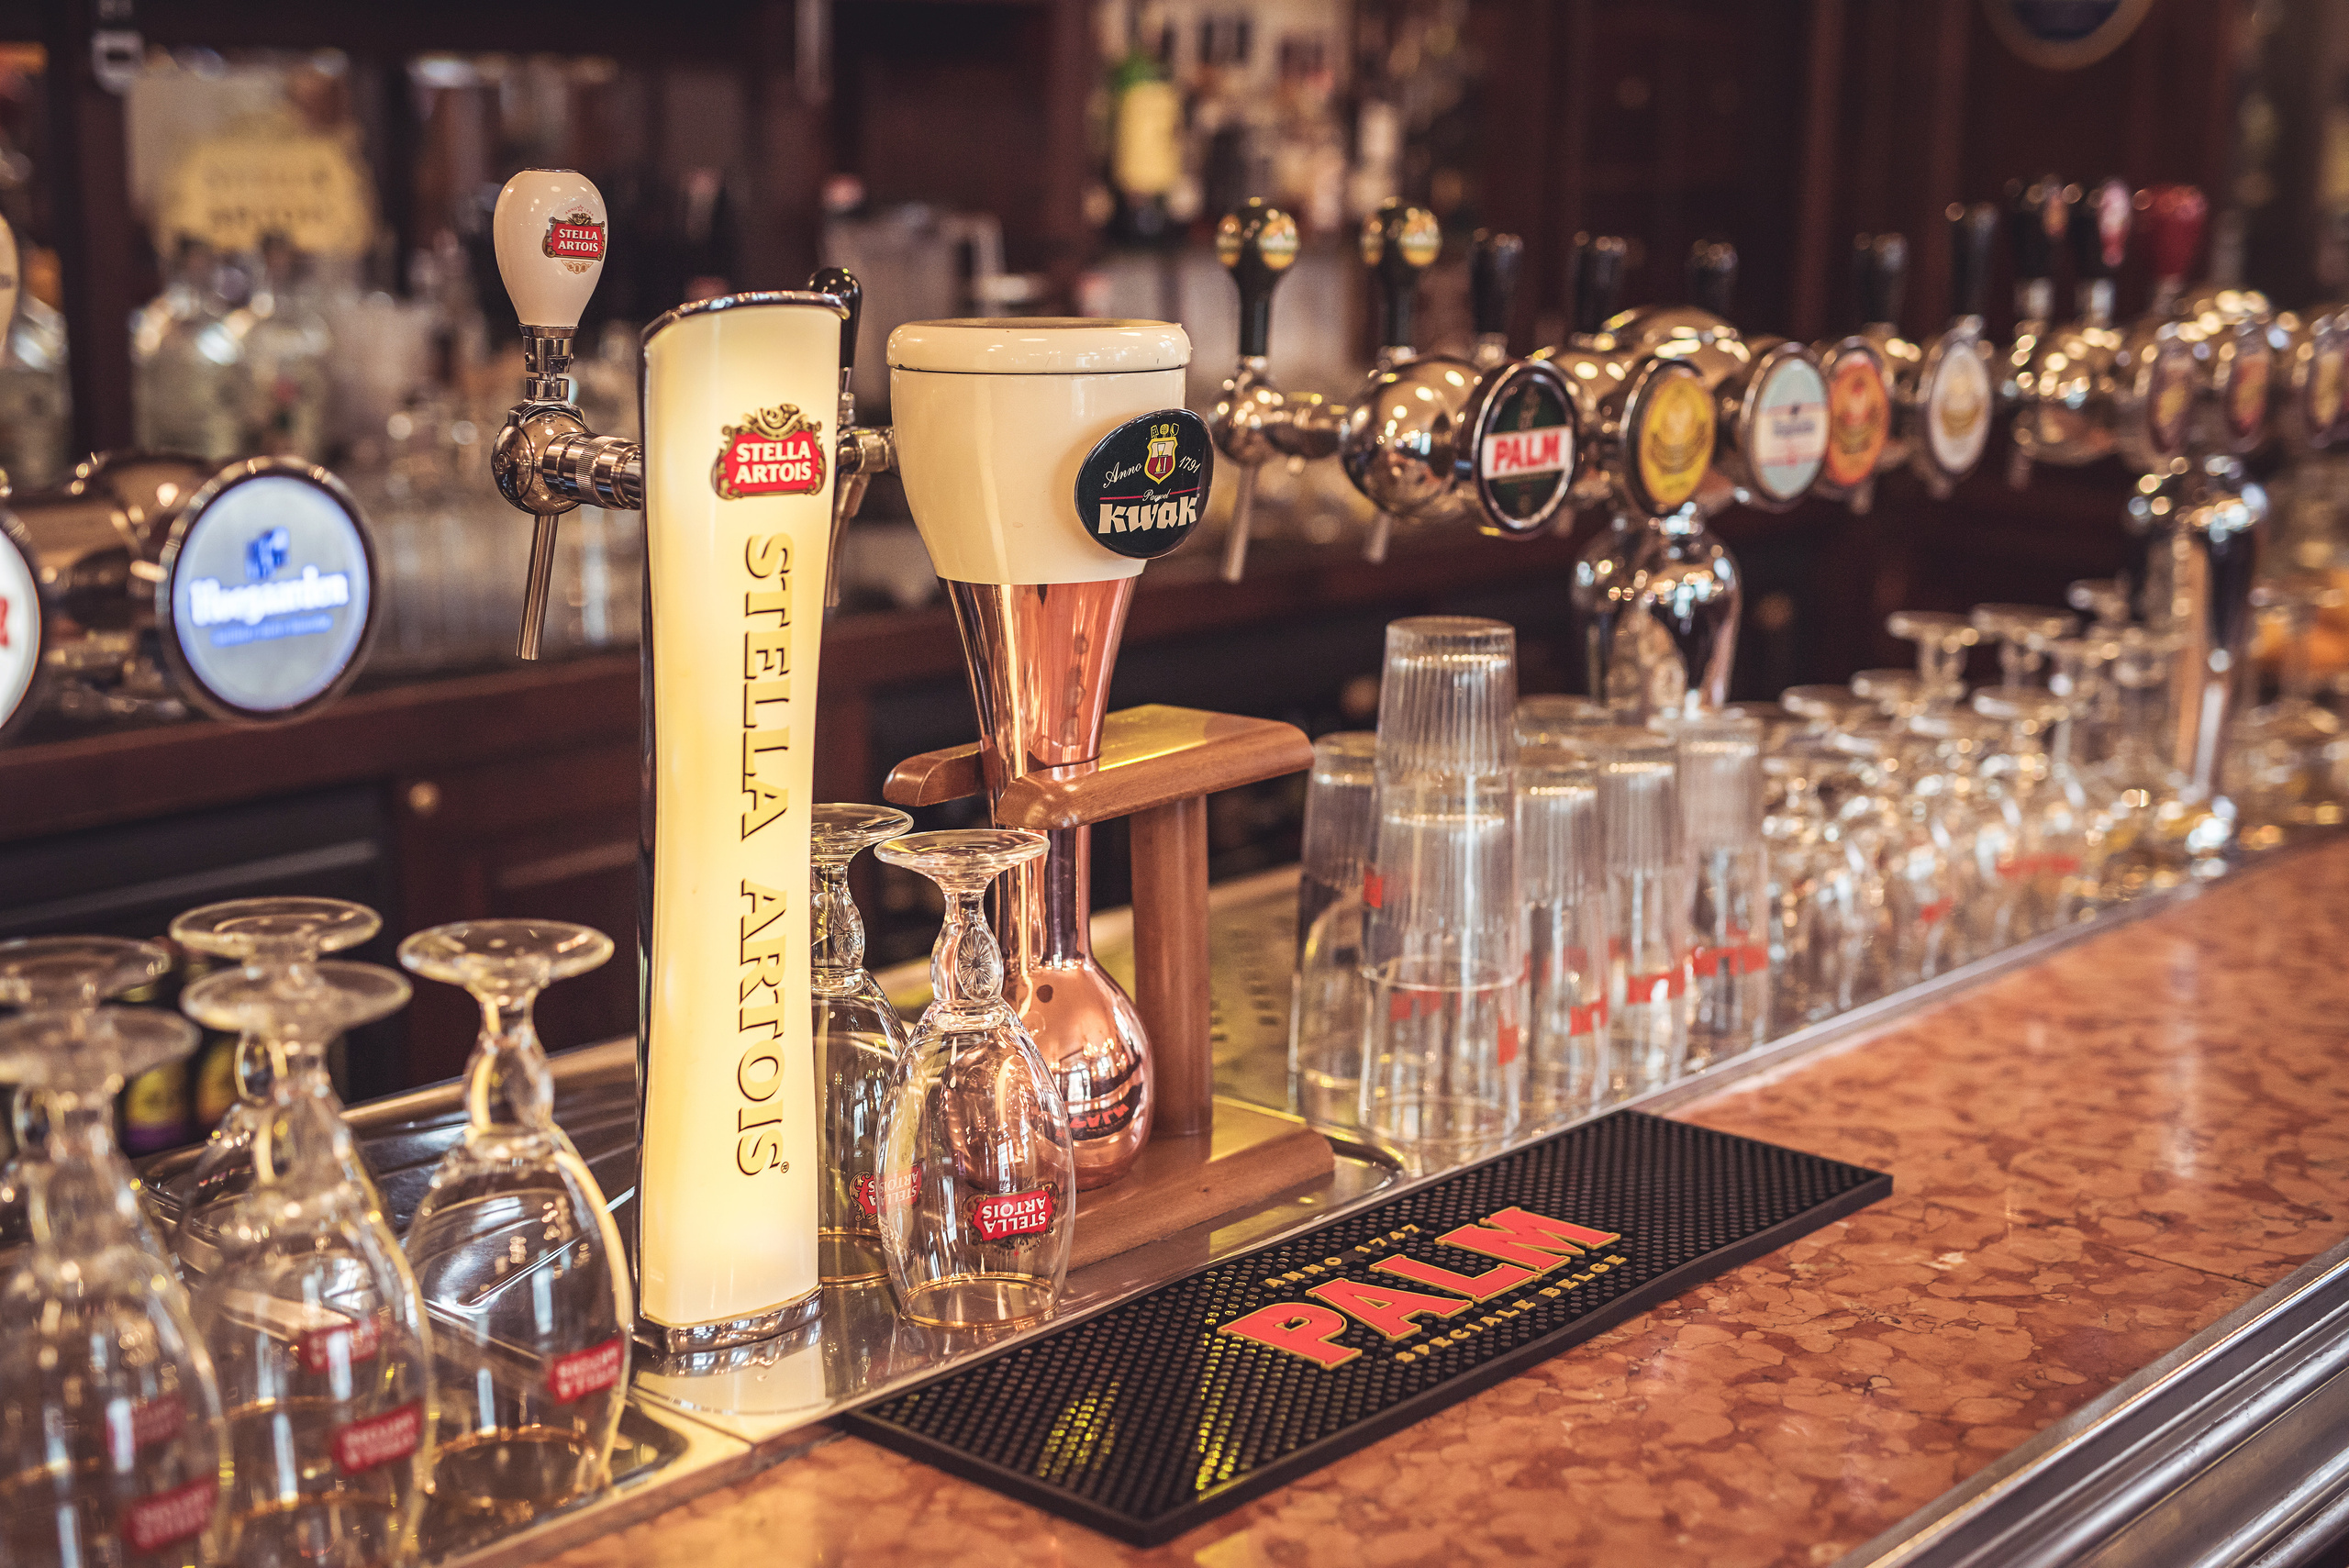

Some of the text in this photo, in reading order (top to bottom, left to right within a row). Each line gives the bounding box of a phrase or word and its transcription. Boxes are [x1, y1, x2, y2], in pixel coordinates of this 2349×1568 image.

[557, 240, 598, 252] ARTOIS
[558, 228, 598, 240] STELLA
[736, 440, 812, 462] STELLA
[1493, 433, 1560, 473] PALM
[734, 462, 812, 484] ARTOIS
[1103, 455, 1201, 489] Anno 1791
[741, 532, 795, 841] STELLA
[982, 1195, 1047, 1219] ARTOIS
[983, 1211, 1046, 1234] STELLA
[1264, 1223, 1420, 1288] ANNO 1747
[1217, 1206, 1621, 1371] PALM
[1395, 1254, 1627, 1363] SPECIALE BELGE
